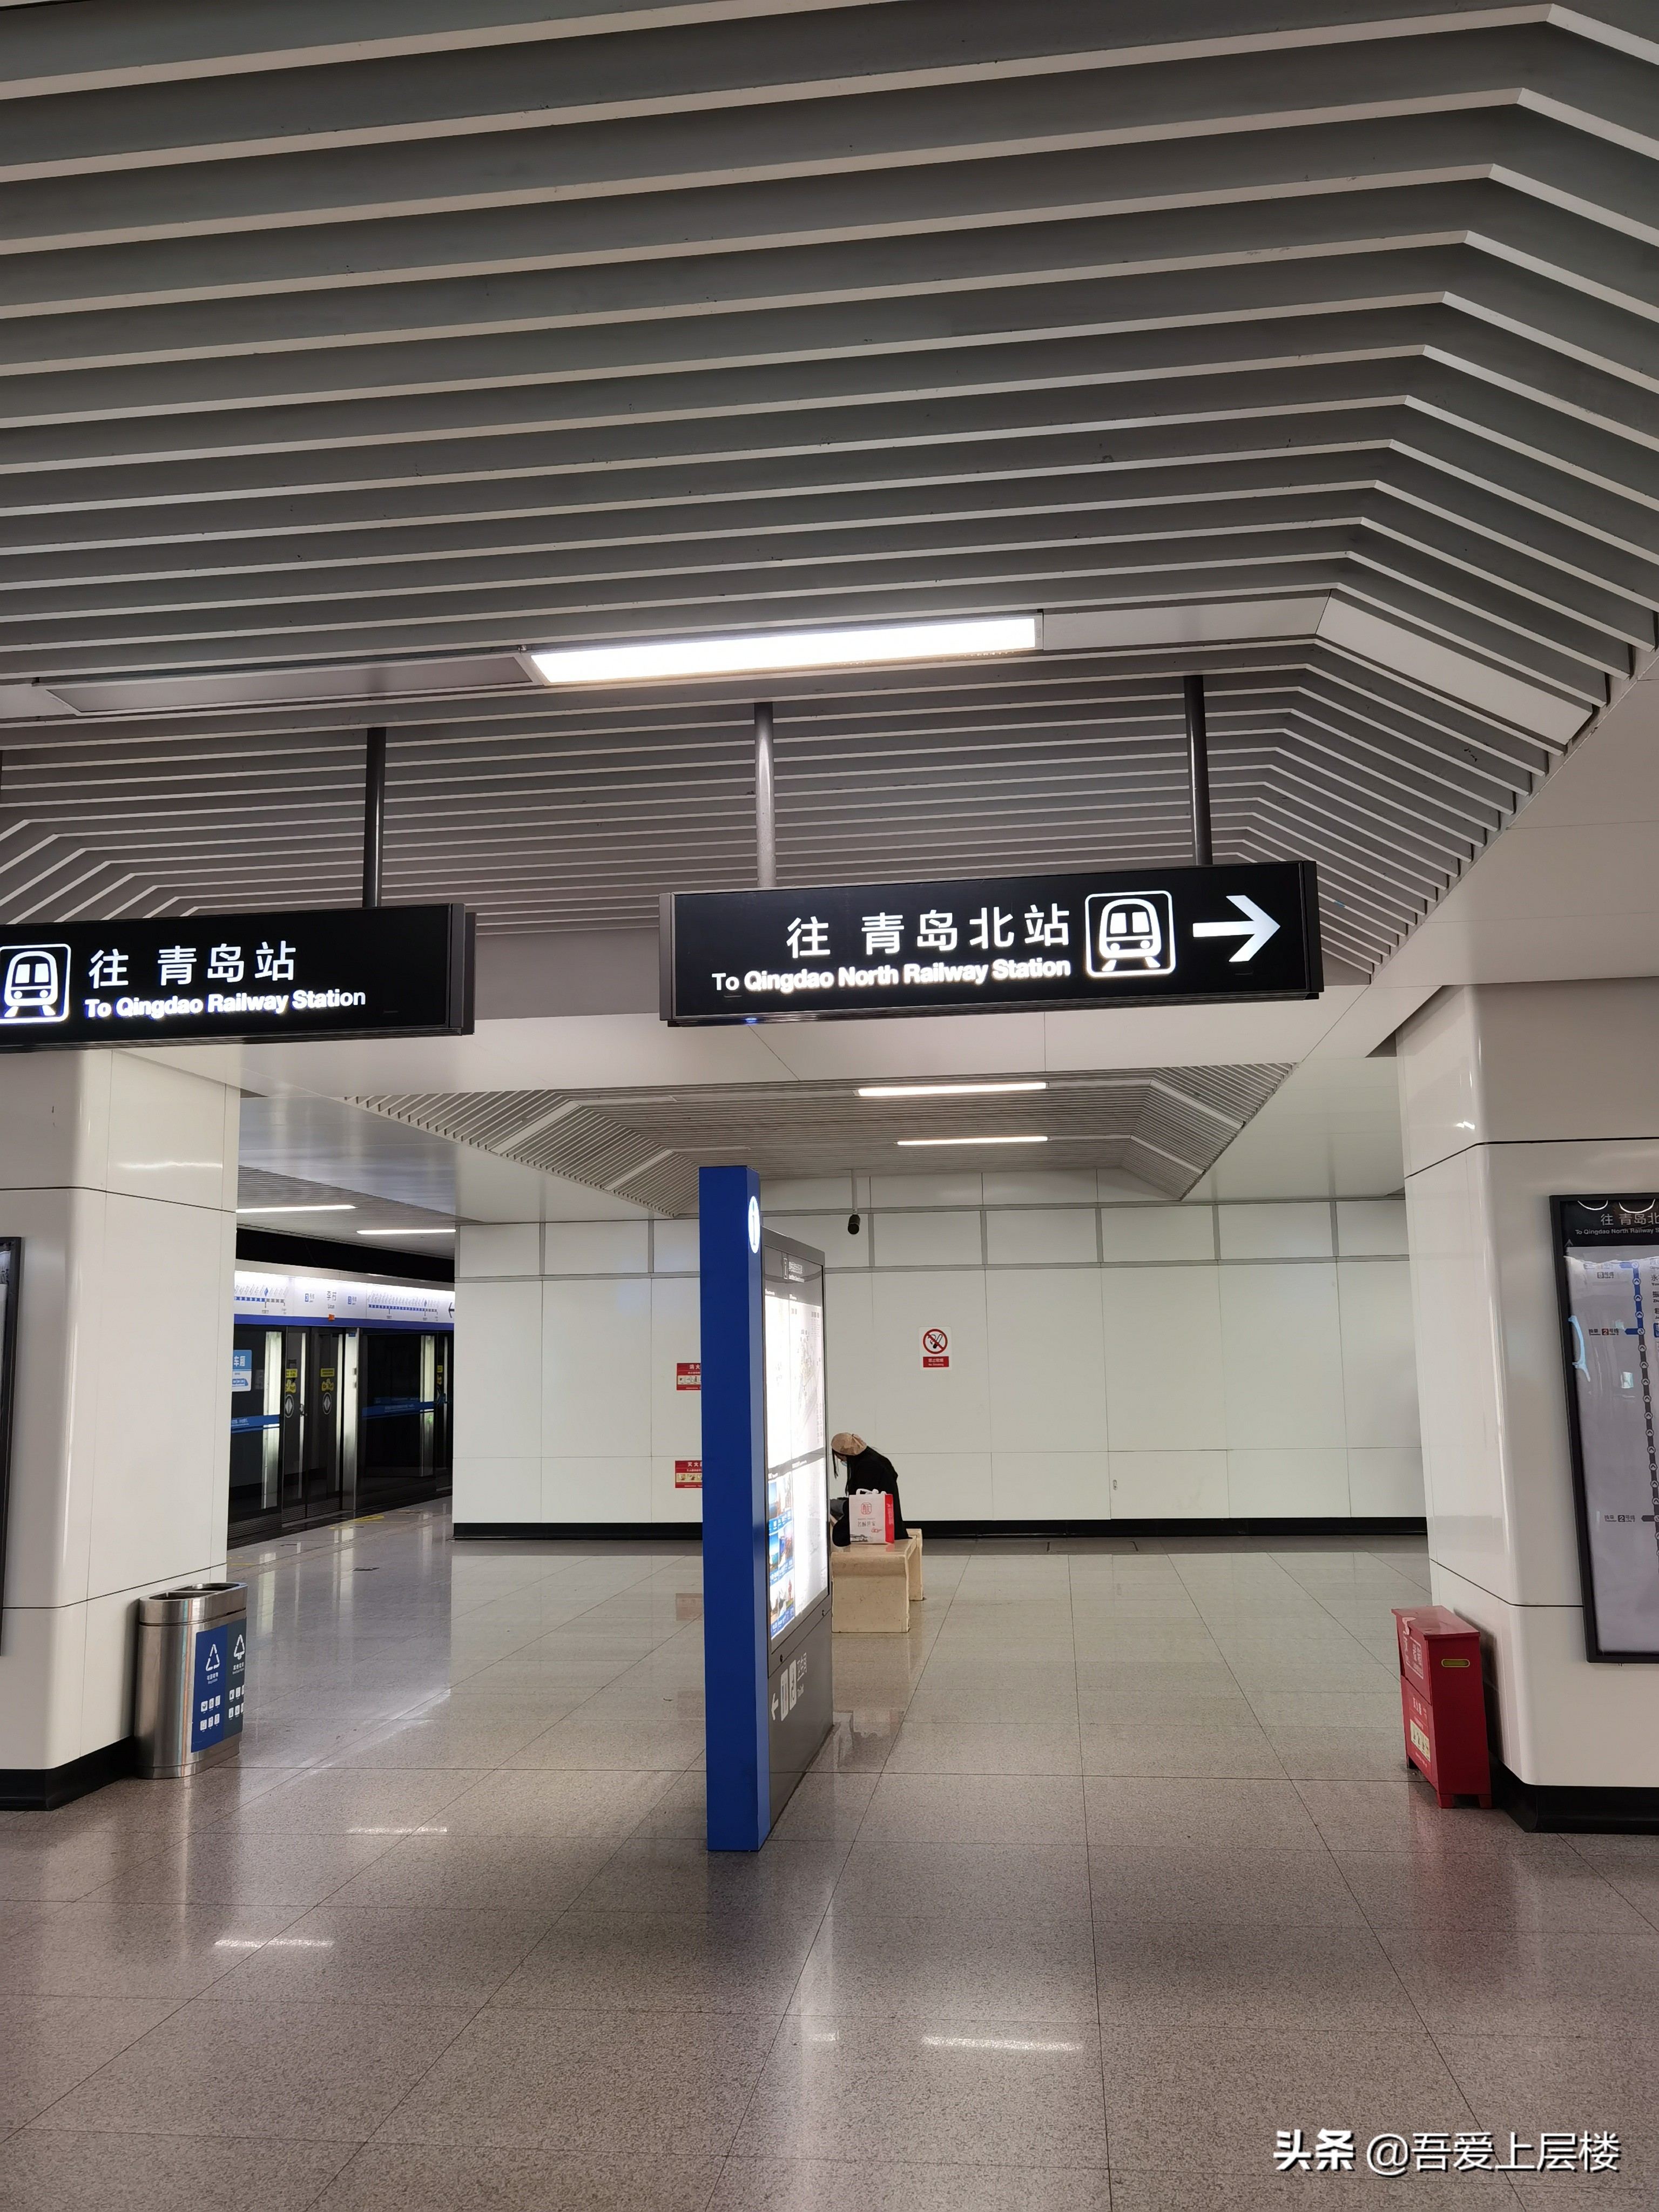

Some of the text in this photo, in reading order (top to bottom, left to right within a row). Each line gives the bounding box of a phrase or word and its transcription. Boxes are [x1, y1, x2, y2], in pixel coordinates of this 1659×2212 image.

[786, 903, 1070, 959] 往 青岛北站
[88, 940, 296, 989] 往 青岛站
[712, 957, 1071, 994] To Qingdao North Railway Station
[84, 988, 366, 1020] To Qingdao Railway Station
[1600, 1213, 1614, 1226] 往
